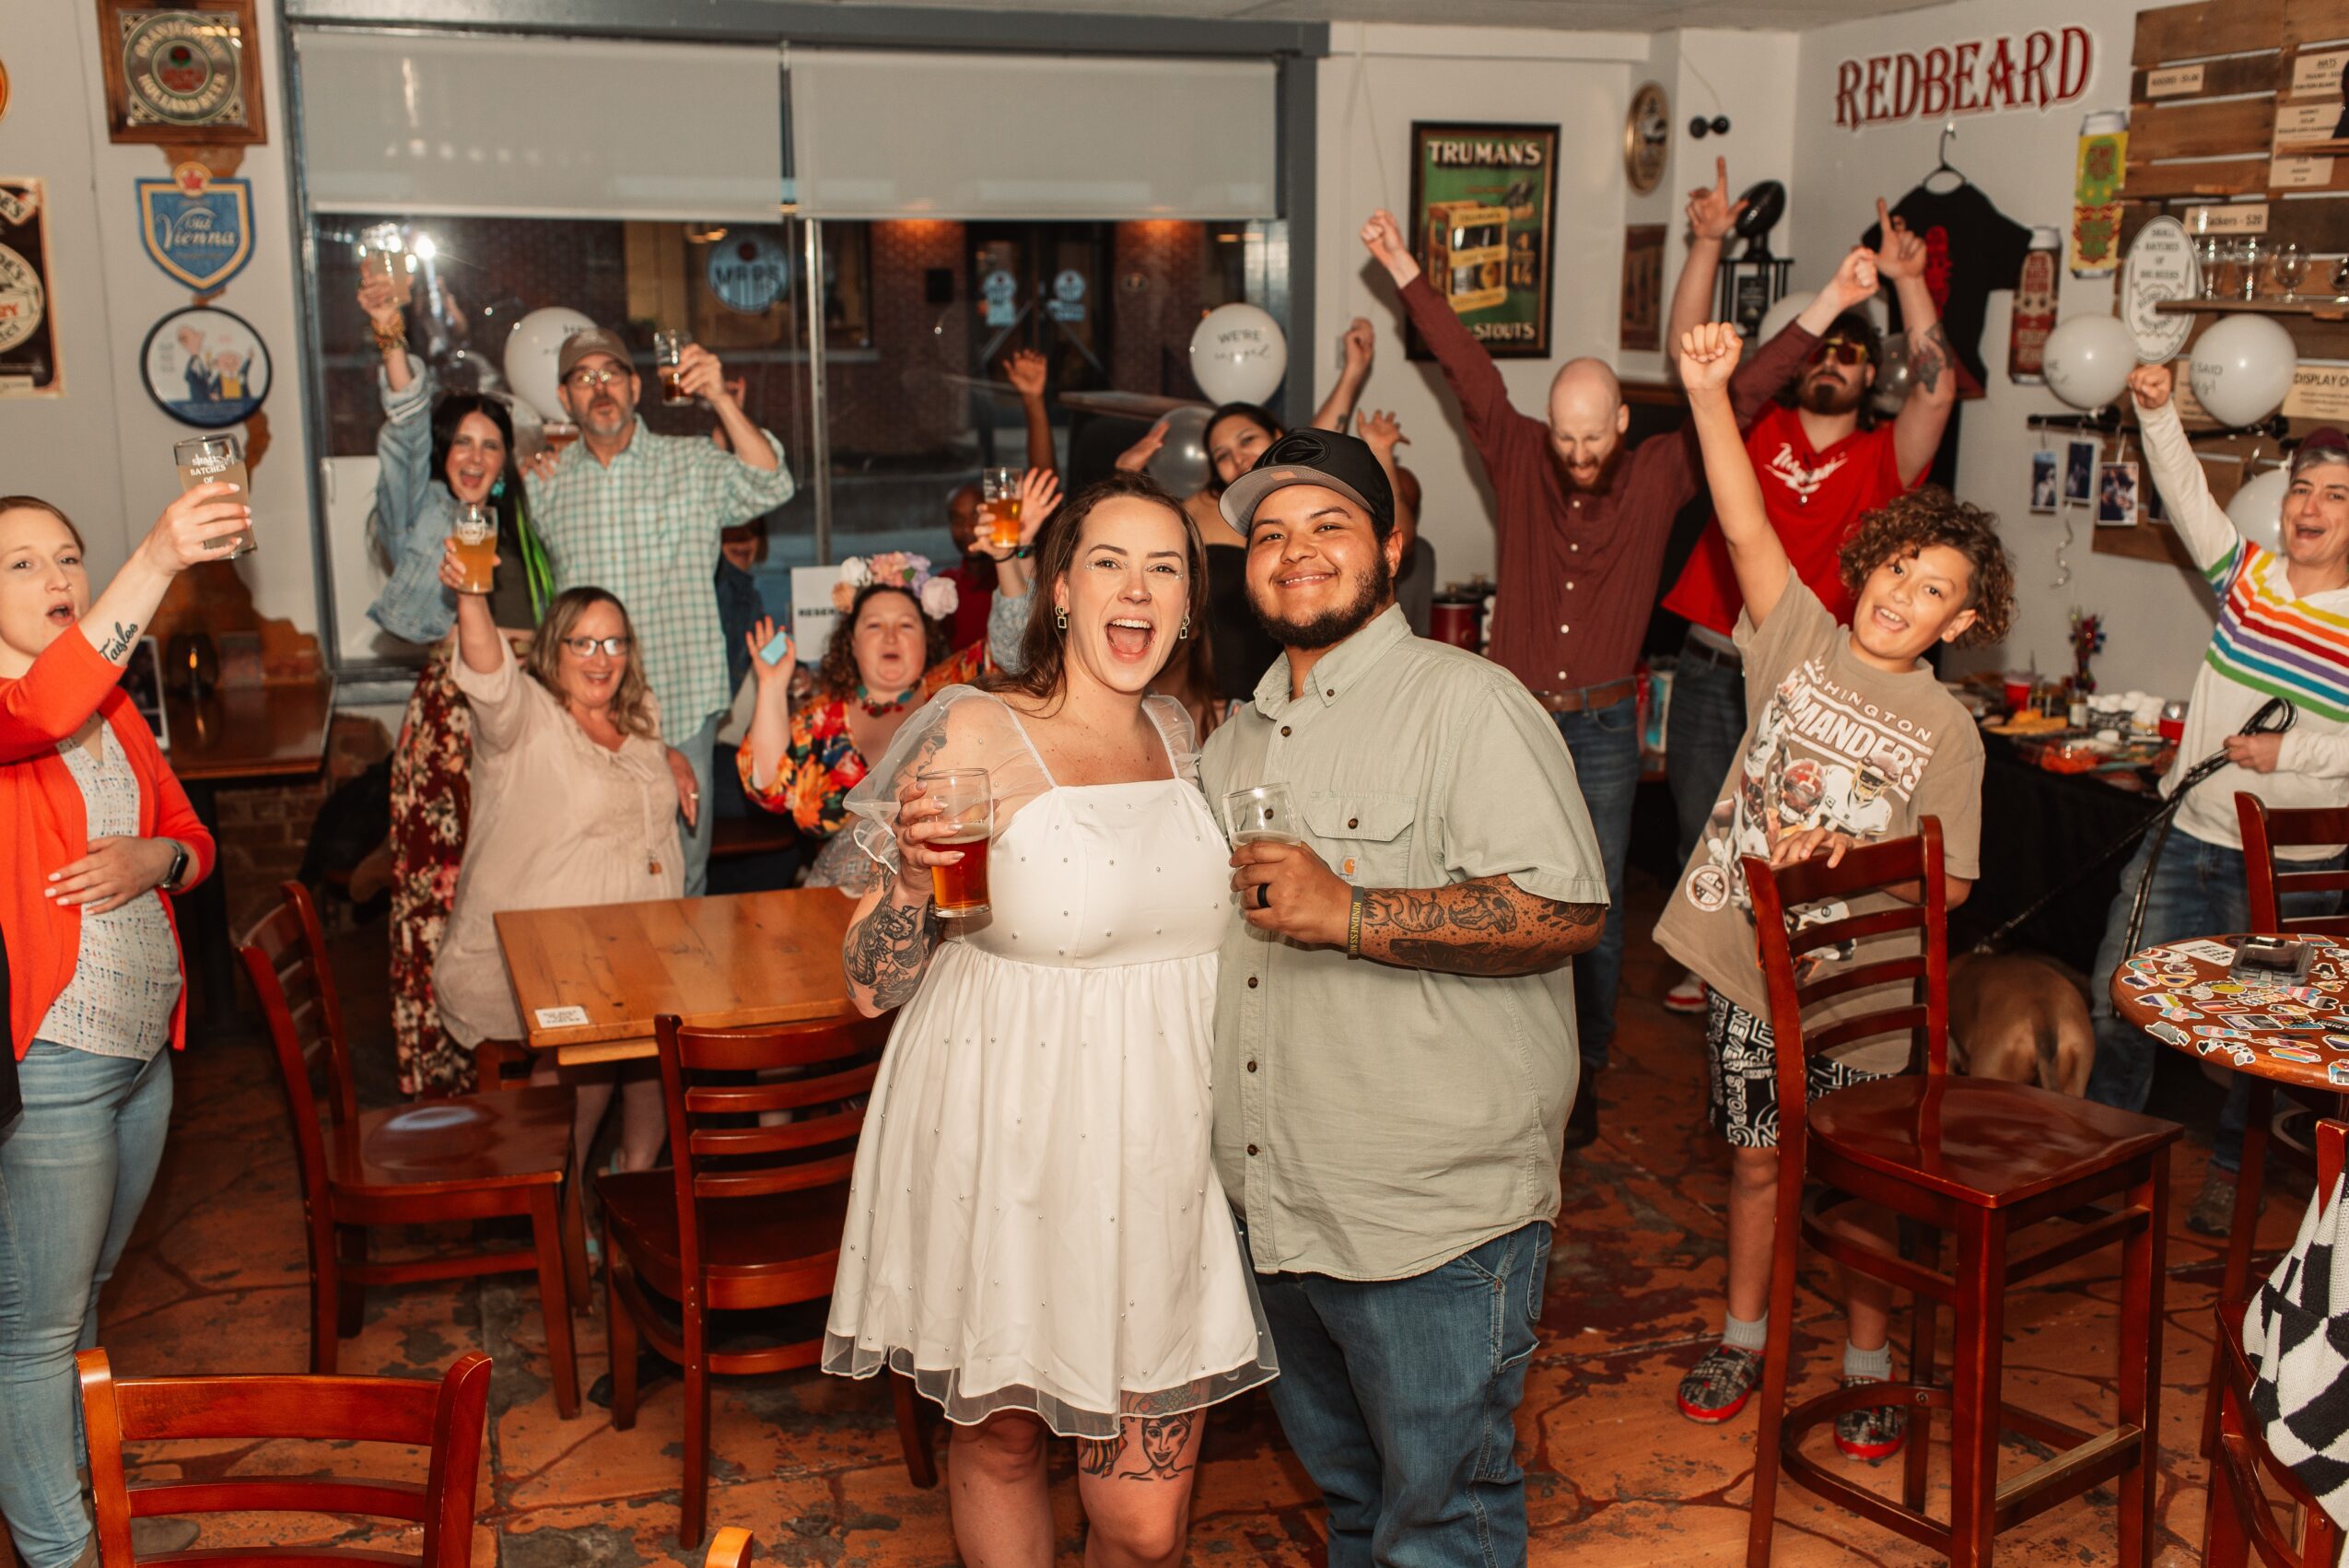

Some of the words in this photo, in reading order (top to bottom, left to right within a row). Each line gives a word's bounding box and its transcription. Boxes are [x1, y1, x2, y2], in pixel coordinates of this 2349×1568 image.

[1836, 27, 2095, 131] REDBEARD
[1428, 140, 1542, 167] TRUMAN'S
[155, 206, 236, 251] Vienna
[1218, 329, 1260, 343] WE'RE
[1474, 323, 1536, 340] STOUTS
[2293, 372, 2337, 386] DISPLAY
[190, 463, 227, 476] BATCHES
[1350, 901, 1361, 944] KINDNESS
